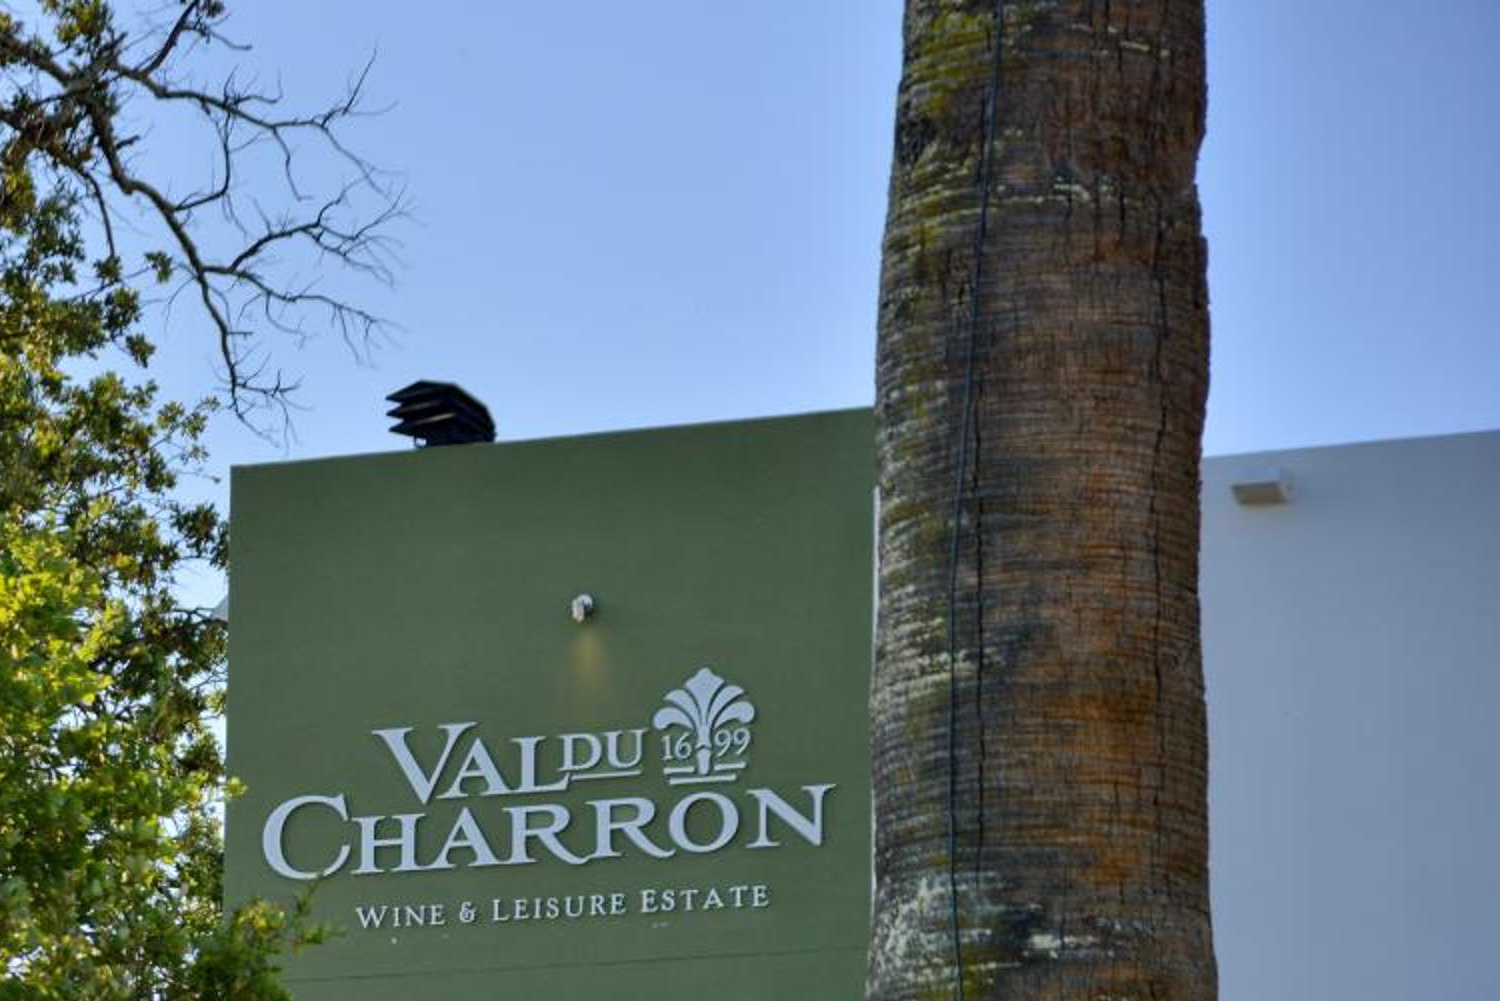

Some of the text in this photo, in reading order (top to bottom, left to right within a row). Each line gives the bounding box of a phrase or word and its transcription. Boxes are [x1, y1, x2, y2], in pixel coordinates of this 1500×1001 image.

[372, 721, 649, 804] VAL DU
[261, 784, 837, 880] CHARRON
[354, 885, 770, 929] WINE & LEISURE ESTATE
